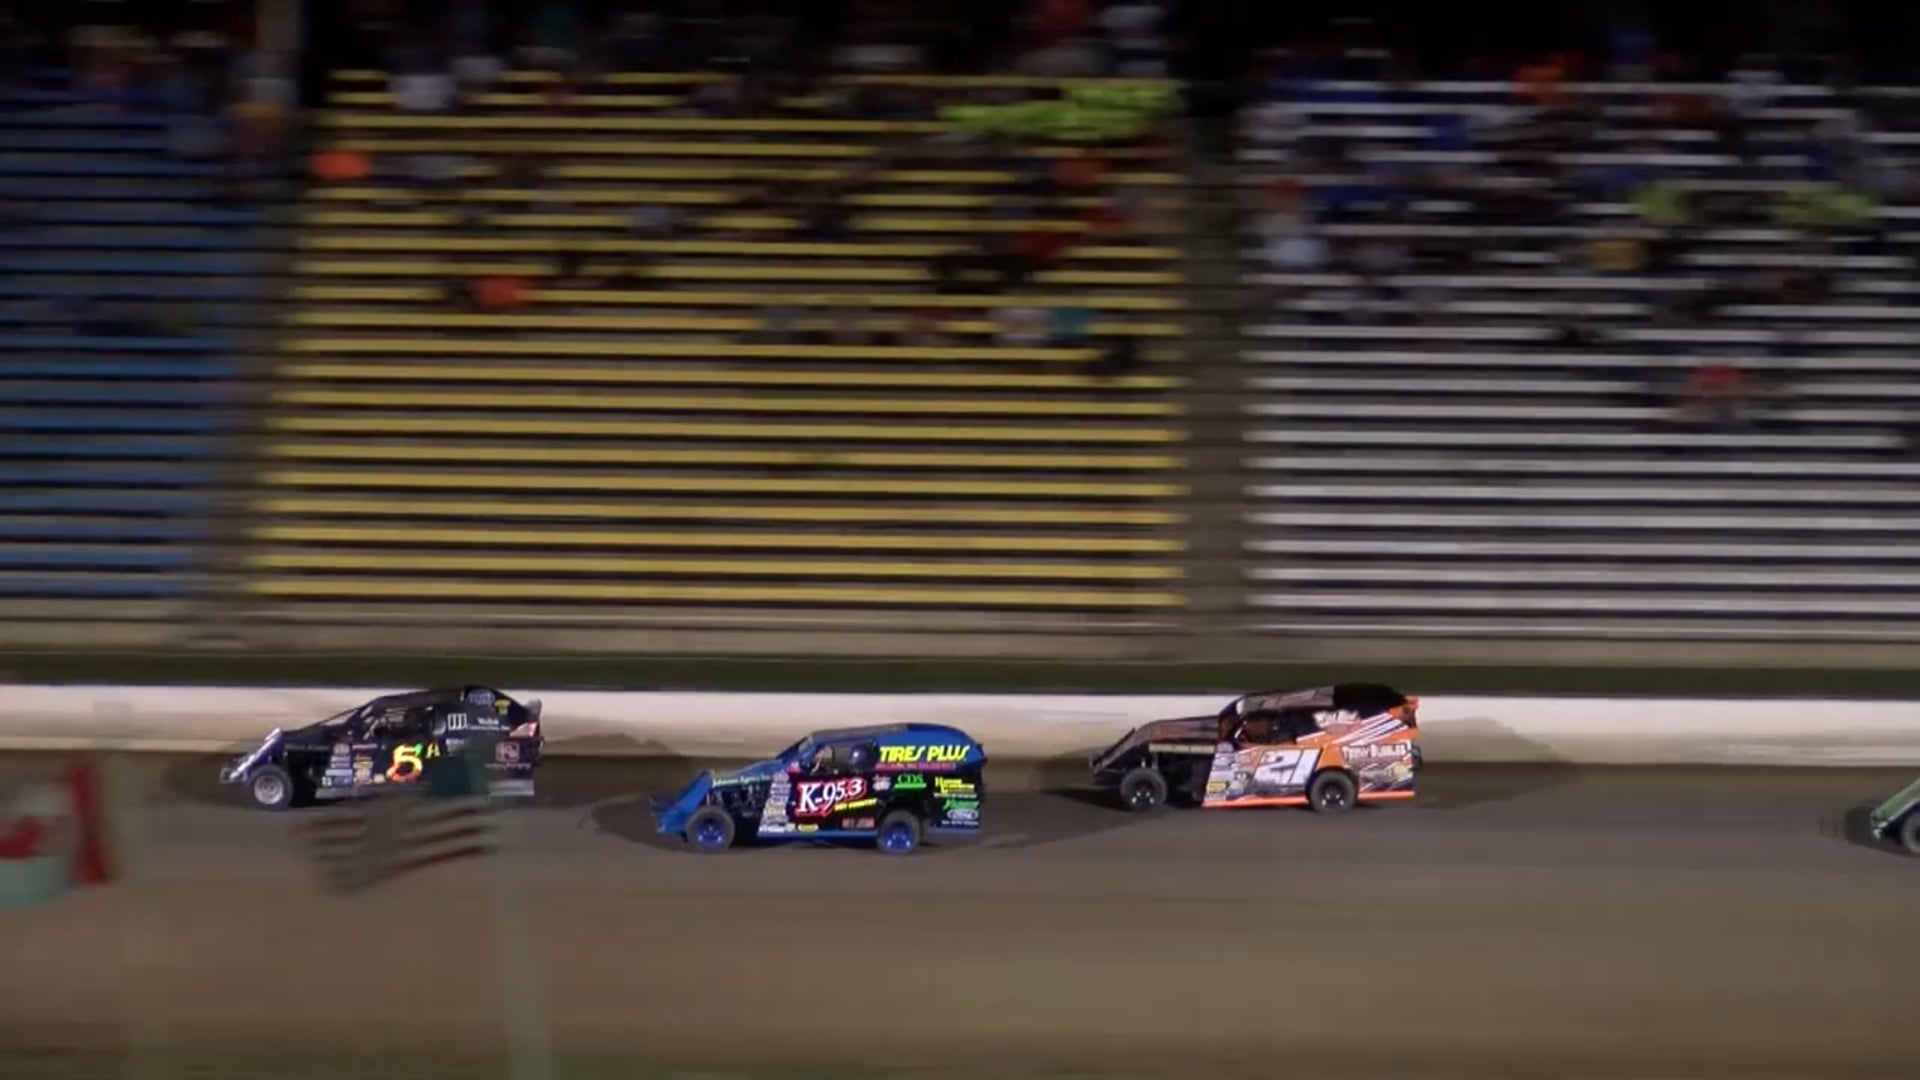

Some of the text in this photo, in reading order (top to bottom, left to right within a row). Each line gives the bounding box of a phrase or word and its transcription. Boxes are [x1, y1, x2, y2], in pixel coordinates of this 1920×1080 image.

[385, 743, 423, 783] 5
[880, 745, 970, 762] TIRES PLUS
[897, 773, 924, 784] CDS
[1254, 749, 1319, 785] 21
